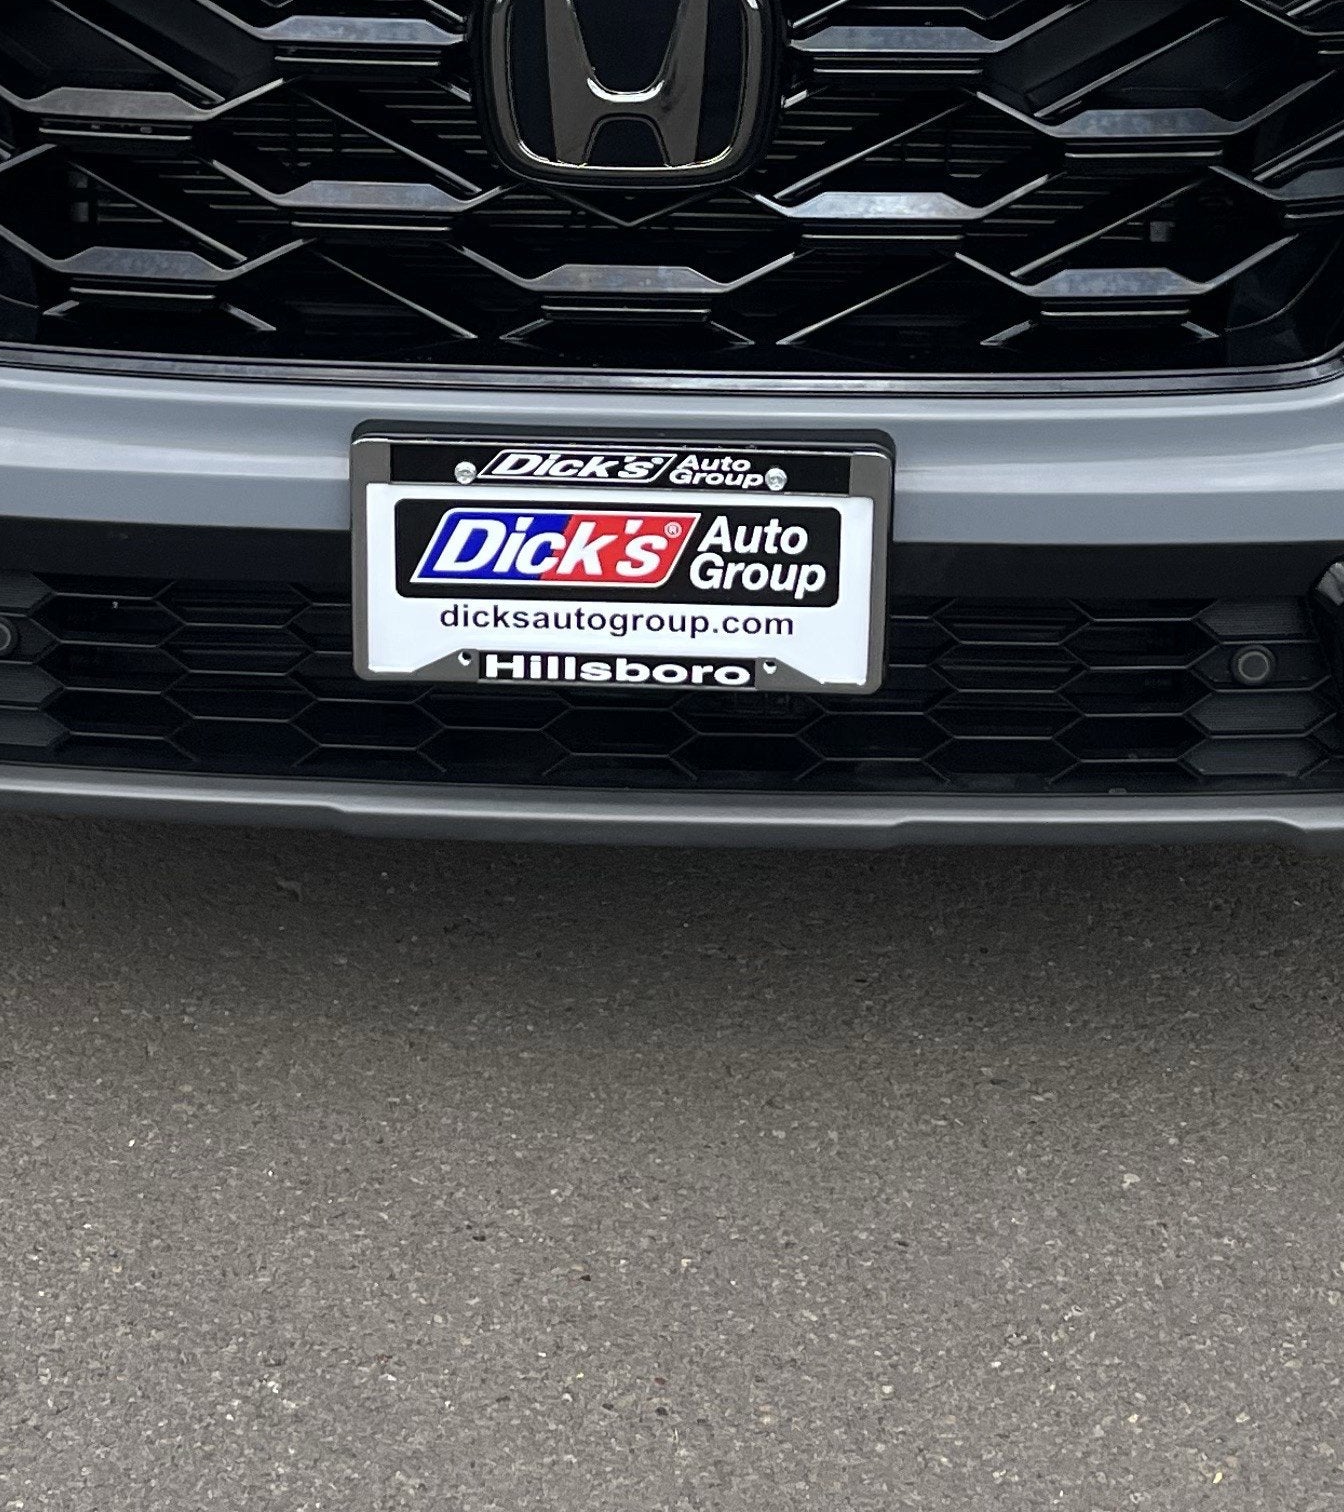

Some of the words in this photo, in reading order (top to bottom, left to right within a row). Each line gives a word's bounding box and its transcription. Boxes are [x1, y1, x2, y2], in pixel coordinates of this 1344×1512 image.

[492, 453, 657, 479] Dick's
[670, 471, 763, 489] Group
[678, 455, 751, 472] Auto
[432, 516, 669, 577] Dick's
[697, 516, 809, 555] Auto
[690, 553, 827, 599] Group
[439, 604, 795, 638] dicksautogroup.com
[485, 654, 751, 686] Hillsboro
